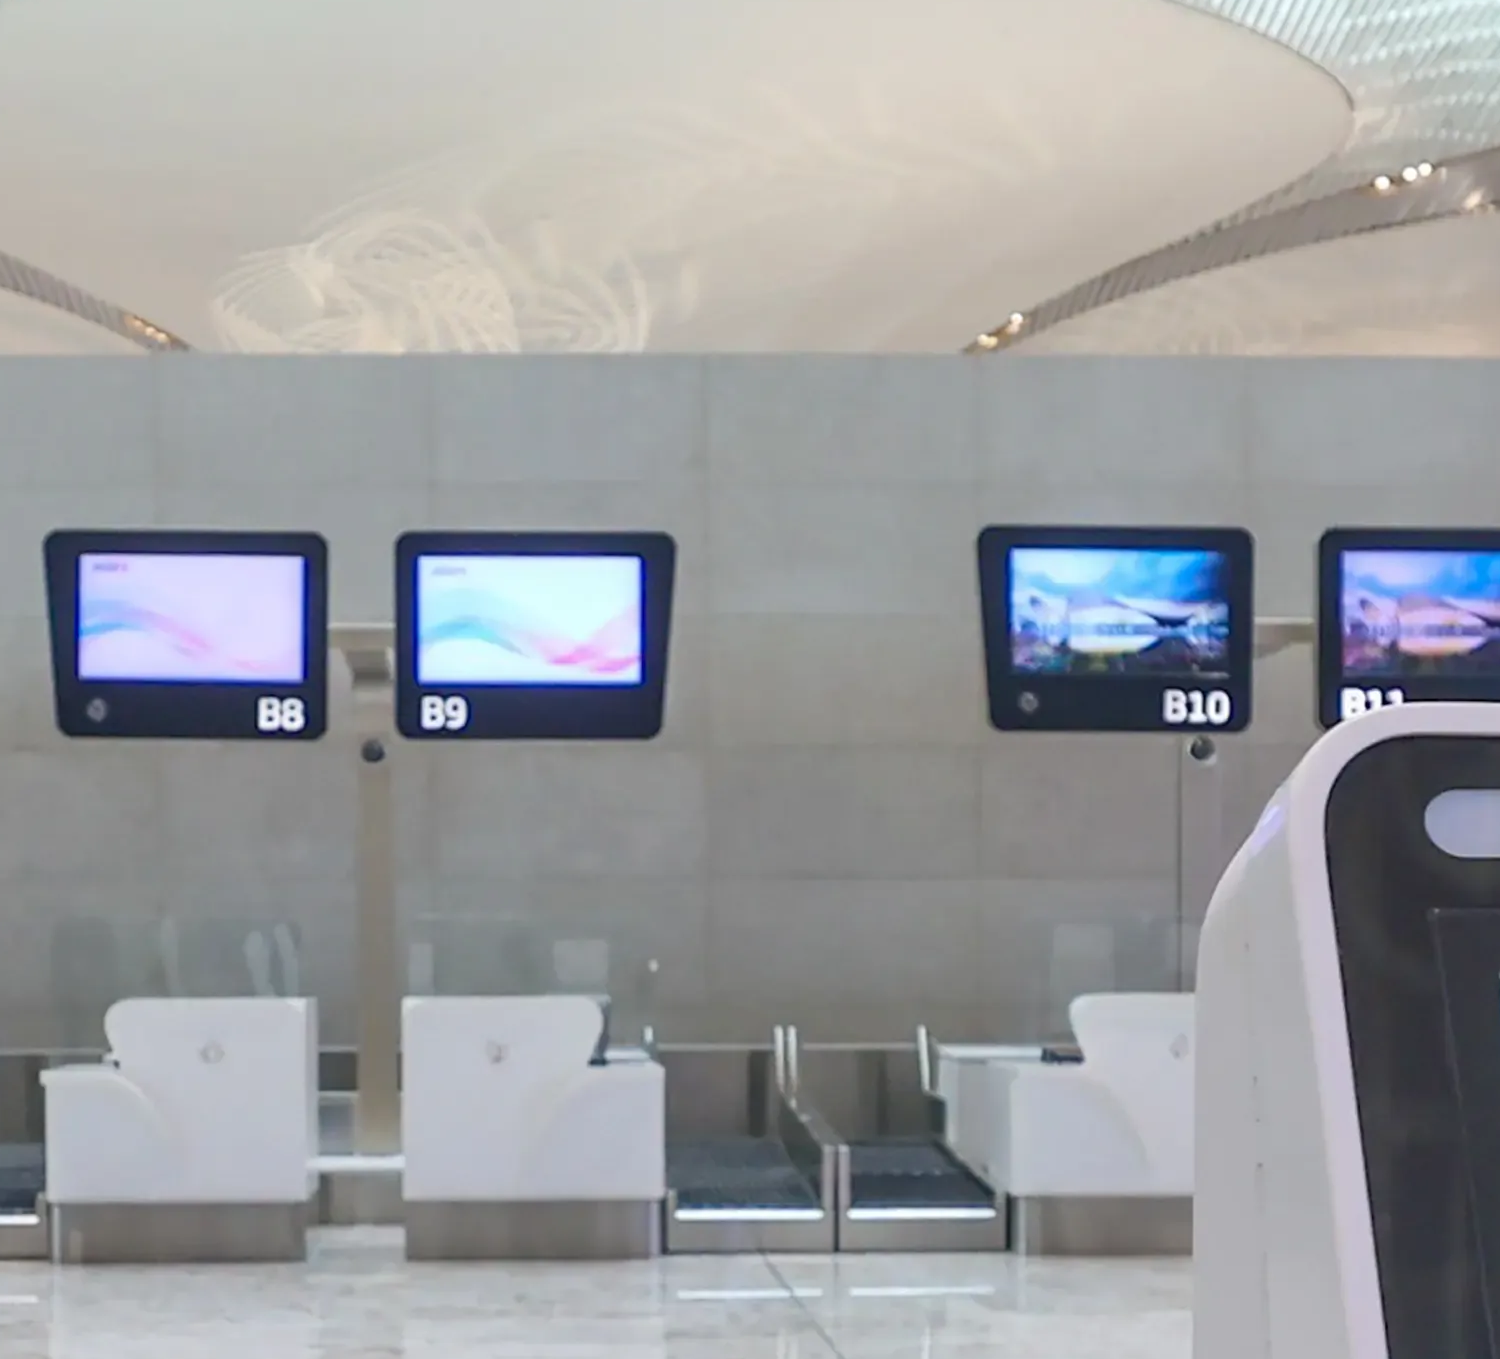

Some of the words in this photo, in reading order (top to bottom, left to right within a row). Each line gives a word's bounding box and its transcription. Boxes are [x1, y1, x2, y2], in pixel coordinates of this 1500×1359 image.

[257, 696, 305, 732] B8
[420, 695, 468, 731] B9
[1162, 688, 1231, 725] B10
